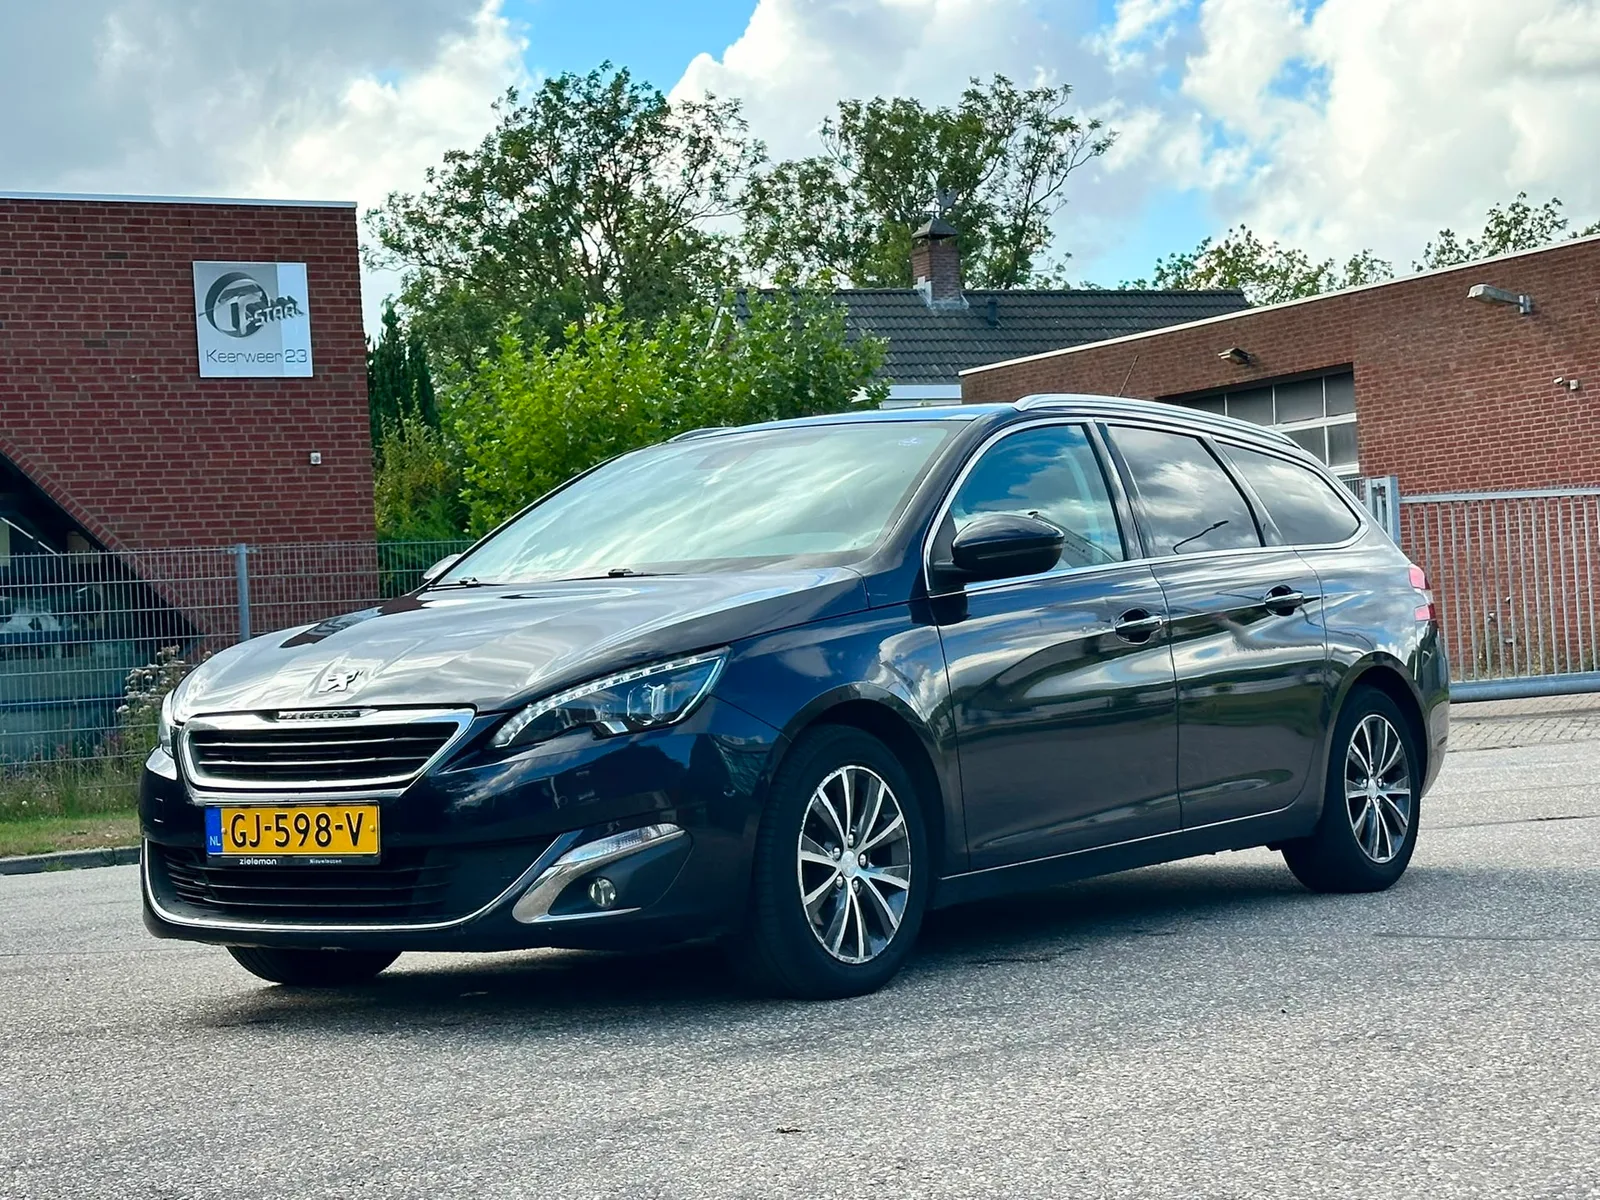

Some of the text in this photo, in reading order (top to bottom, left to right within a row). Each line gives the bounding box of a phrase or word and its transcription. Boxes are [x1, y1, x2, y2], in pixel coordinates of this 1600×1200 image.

[206, 349, 307, 363] Keerweer 23
[231, 812, 364, 847] GJ-598-V
[209, 835, 221, 846] NL
